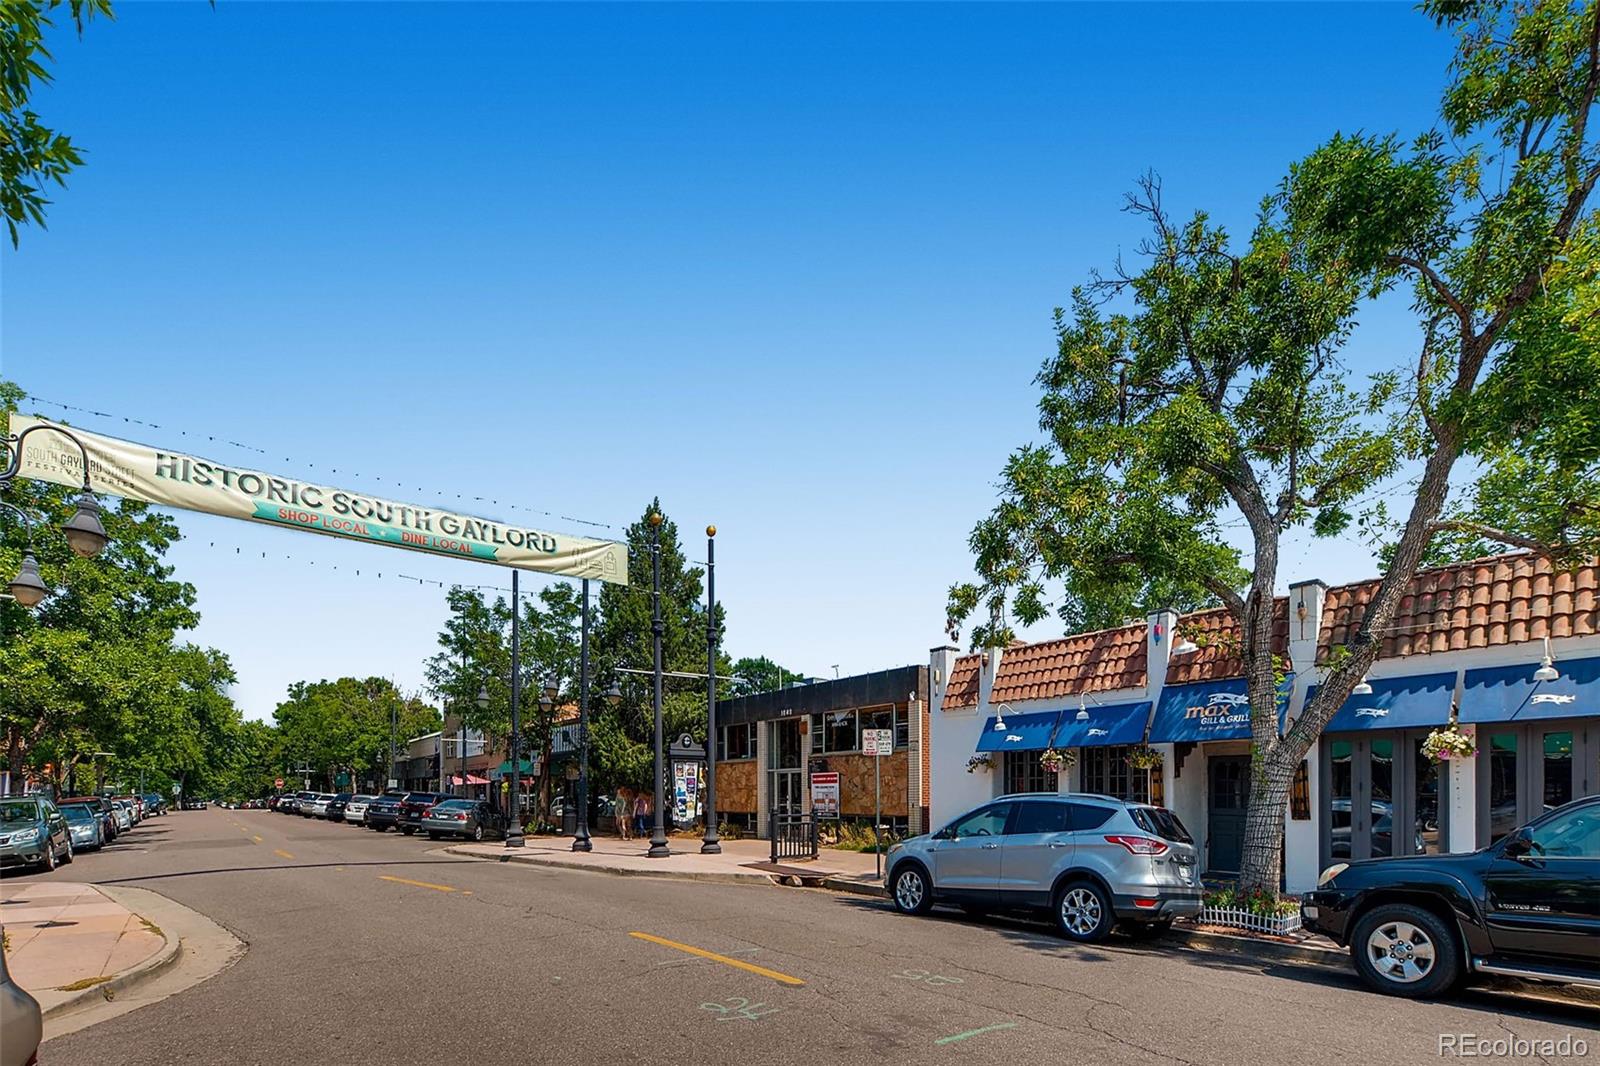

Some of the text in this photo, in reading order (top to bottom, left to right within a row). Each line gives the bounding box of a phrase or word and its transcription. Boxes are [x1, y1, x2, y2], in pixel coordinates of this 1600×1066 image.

[26, 446, 58, 462] SOUTH
[61, 454, 102, 473] GAYLRD
[155, 452, 557, 554] HISTORIC SOUTH GAYLORD
[278, 508, 370, 536] SHOP LOCAL
[401, 531, 473, 554] DINE LOCAL
[1185, 705, 1231, 719] max
[1201, 714, 1250, 725] GILL & GRILL
